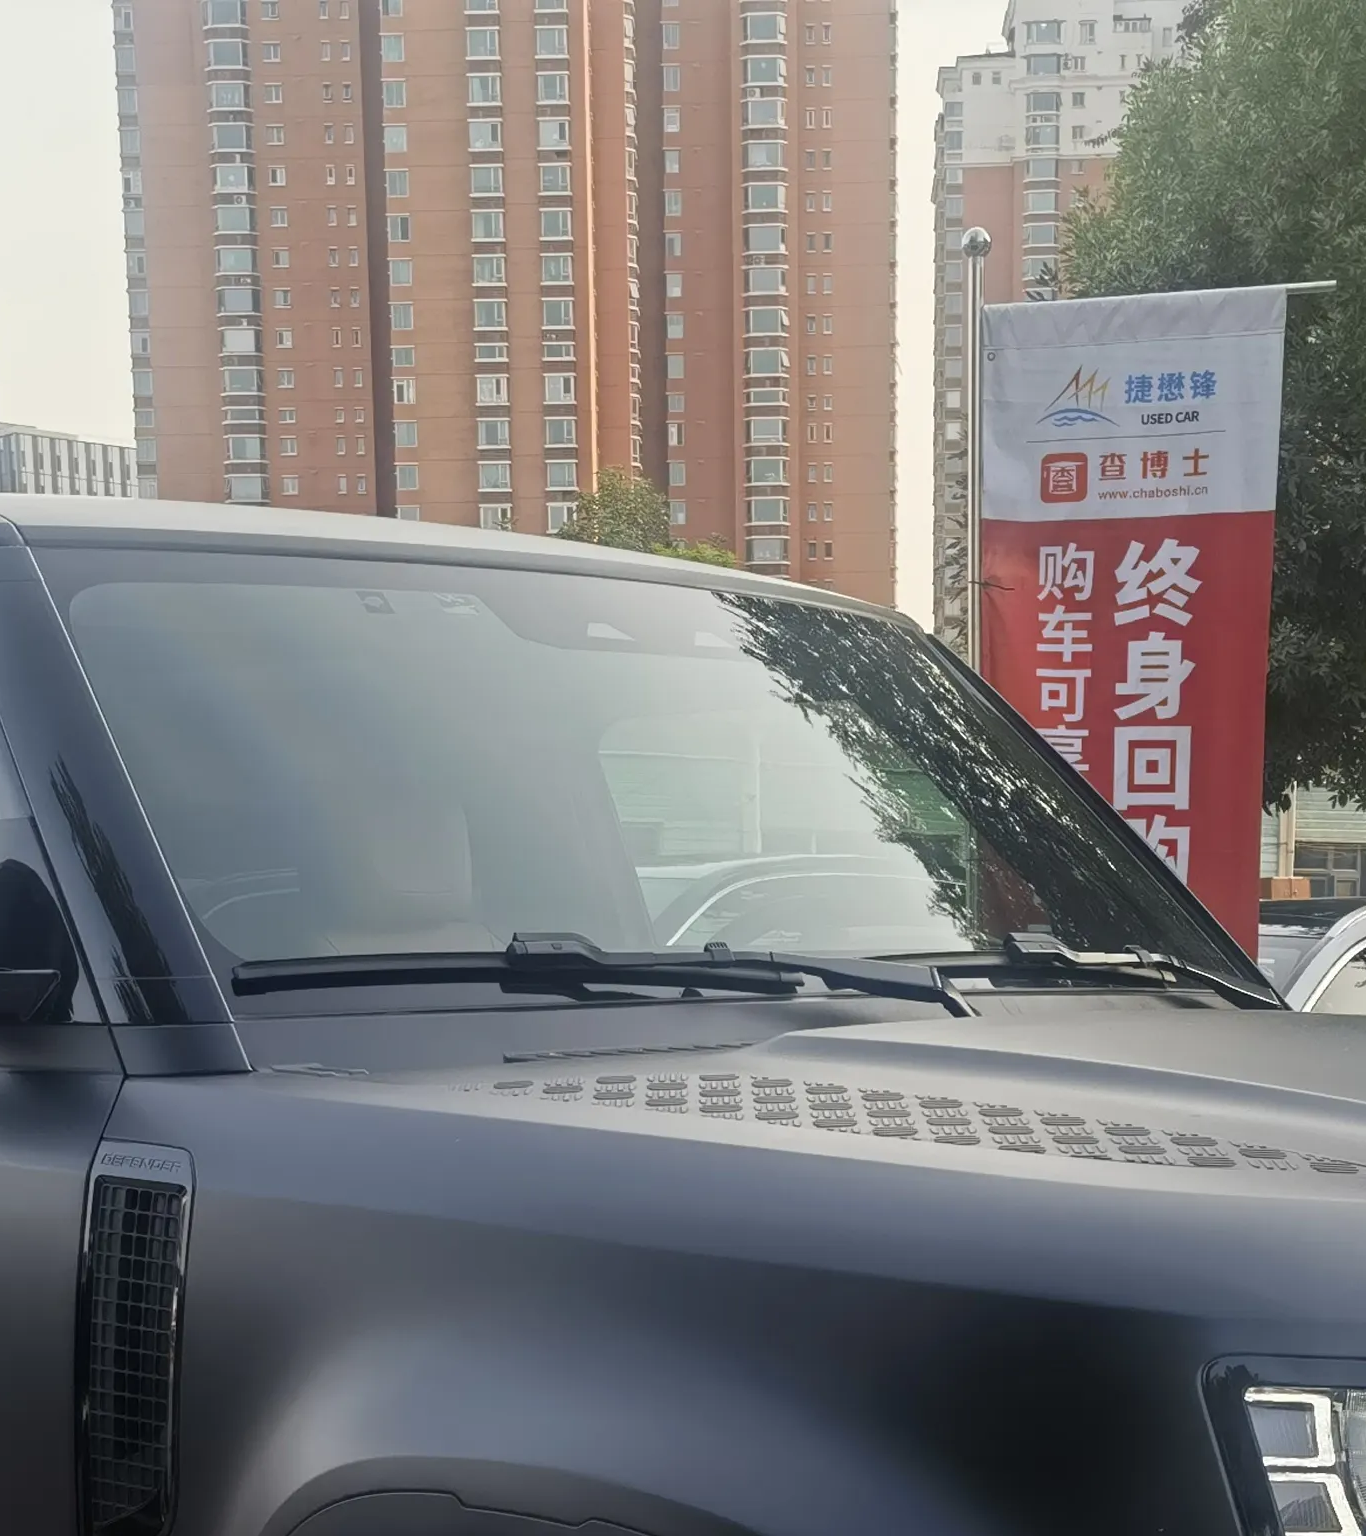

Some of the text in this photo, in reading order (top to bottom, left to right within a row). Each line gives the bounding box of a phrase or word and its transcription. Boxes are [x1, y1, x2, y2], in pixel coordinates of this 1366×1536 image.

[1124, 369, 1217, 404] 捷懋锋
[1141, 411, 1200, 426] USED CAR
[1098, 448, 1210, 481] 查博士
[1098, 486, 1208, 500] www.chaboshi.cn
